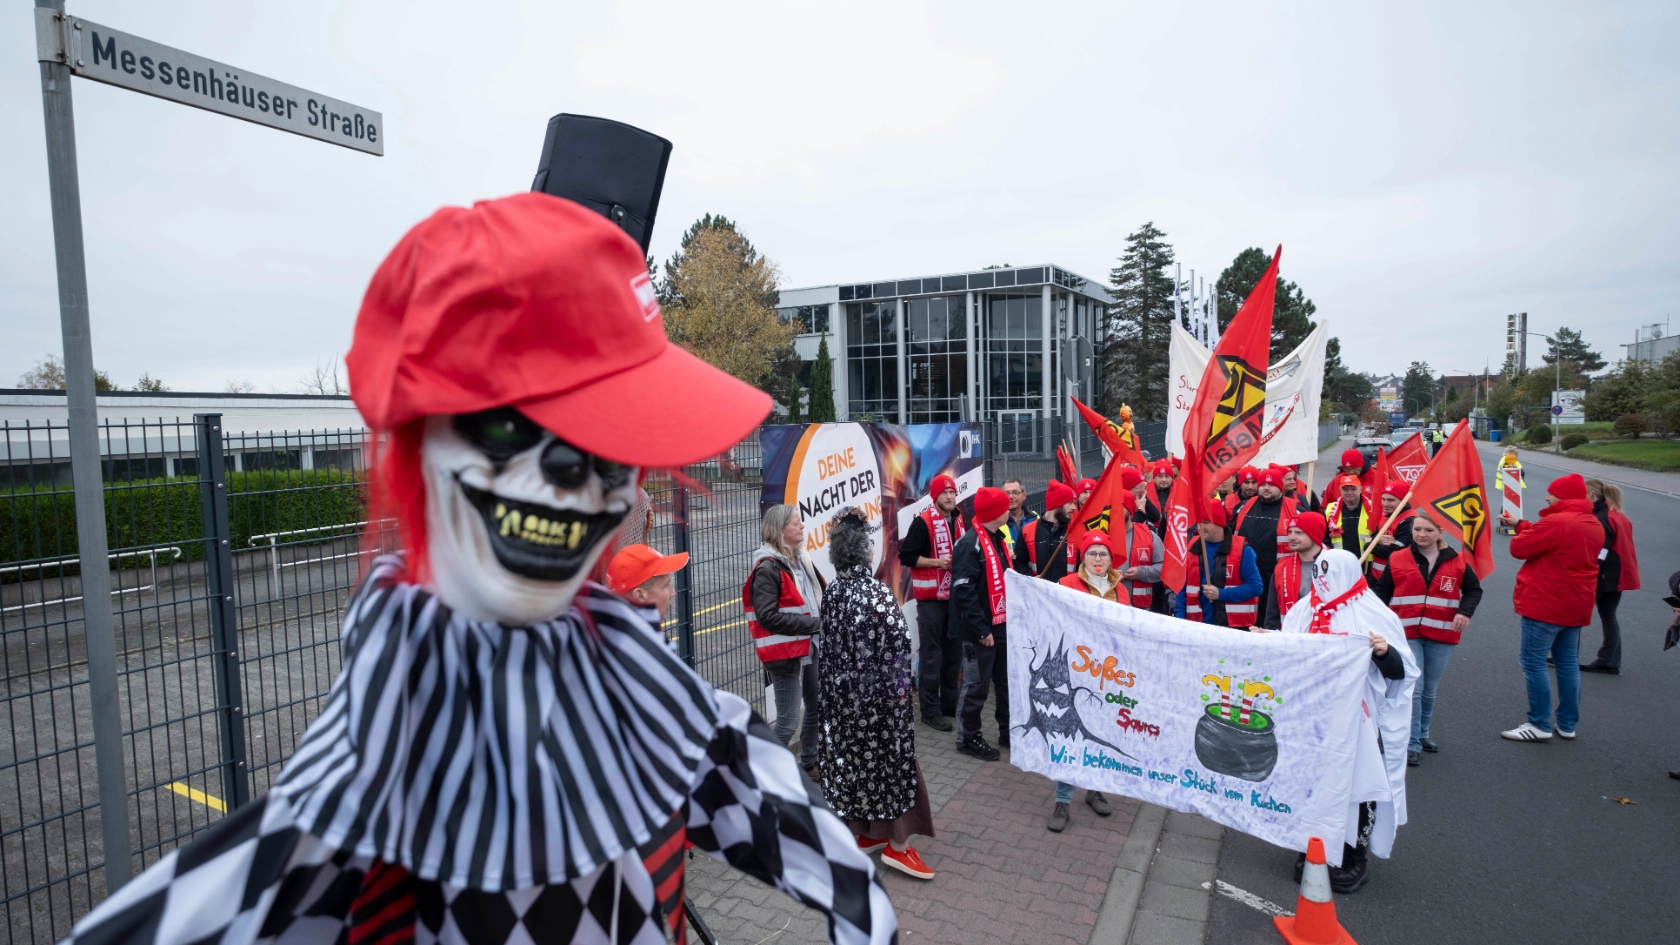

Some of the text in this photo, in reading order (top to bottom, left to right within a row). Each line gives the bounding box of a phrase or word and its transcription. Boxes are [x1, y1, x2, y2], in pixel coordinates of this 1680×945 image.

[91, 31, 378, 143] Messenhäuser Straße
[817, 447, 855, 481] DEINE
[799, 469, 875, 522] NACHT DER
[1071, 645, 1136, 691] Süßes
[1105, 690, 1138, 709] oder
[1116, 708, 1160, 737] Saures
[1050, 744, 1291, 814] Wir bekommen unser Stück vom Kuchen
